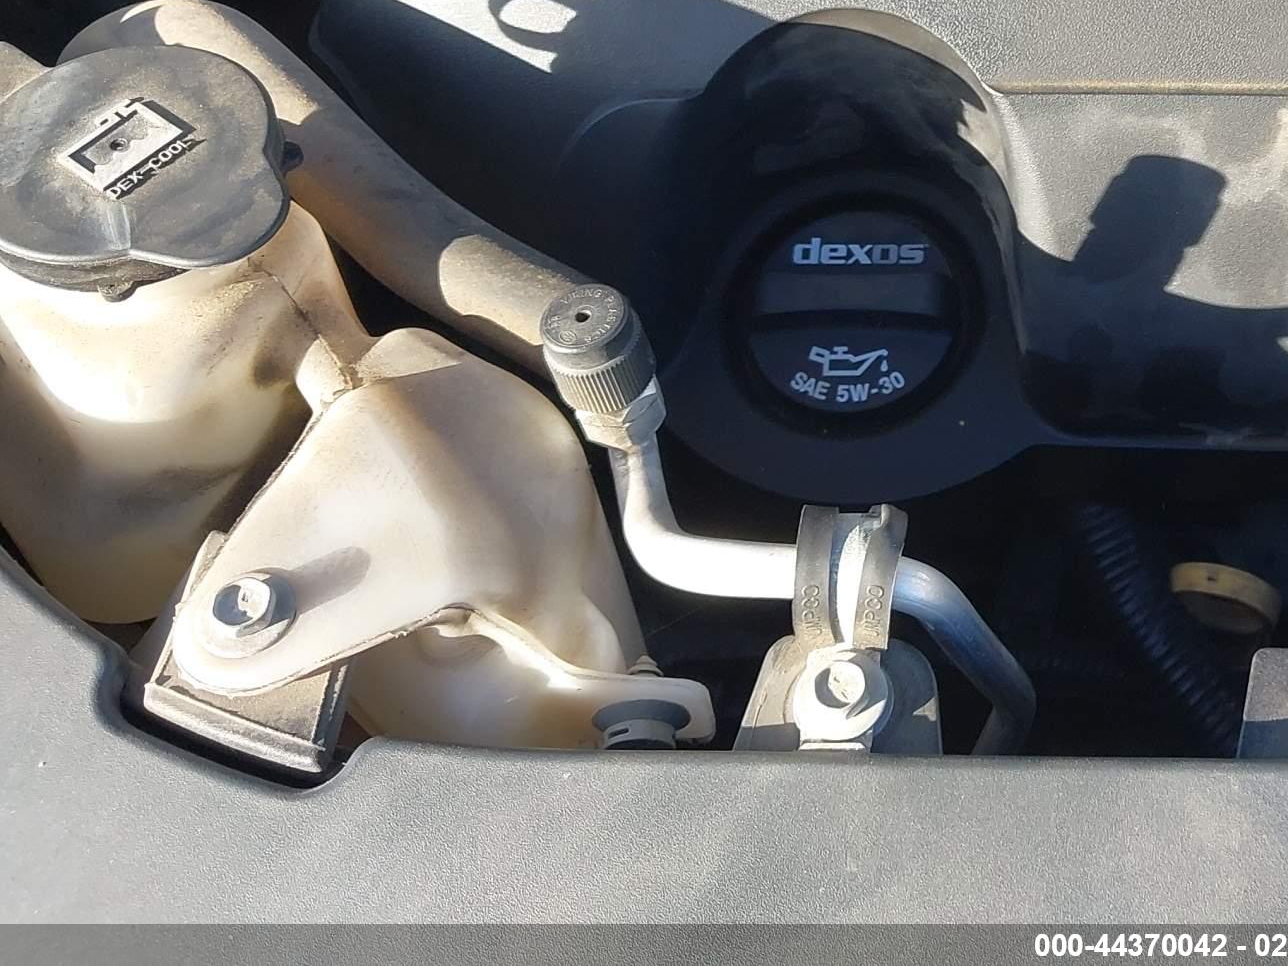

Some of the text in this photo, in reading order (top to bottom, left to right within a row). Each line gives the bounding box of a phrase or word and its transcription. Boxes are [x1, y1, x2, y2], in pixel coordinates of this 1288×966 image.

[105, 138, 195, 199] DEX-COOL
[792, 237, 926, 265] dexos
[559, 288, 603, 304] VIKING
[790, 370, 906, 403] SAE 5W-30
